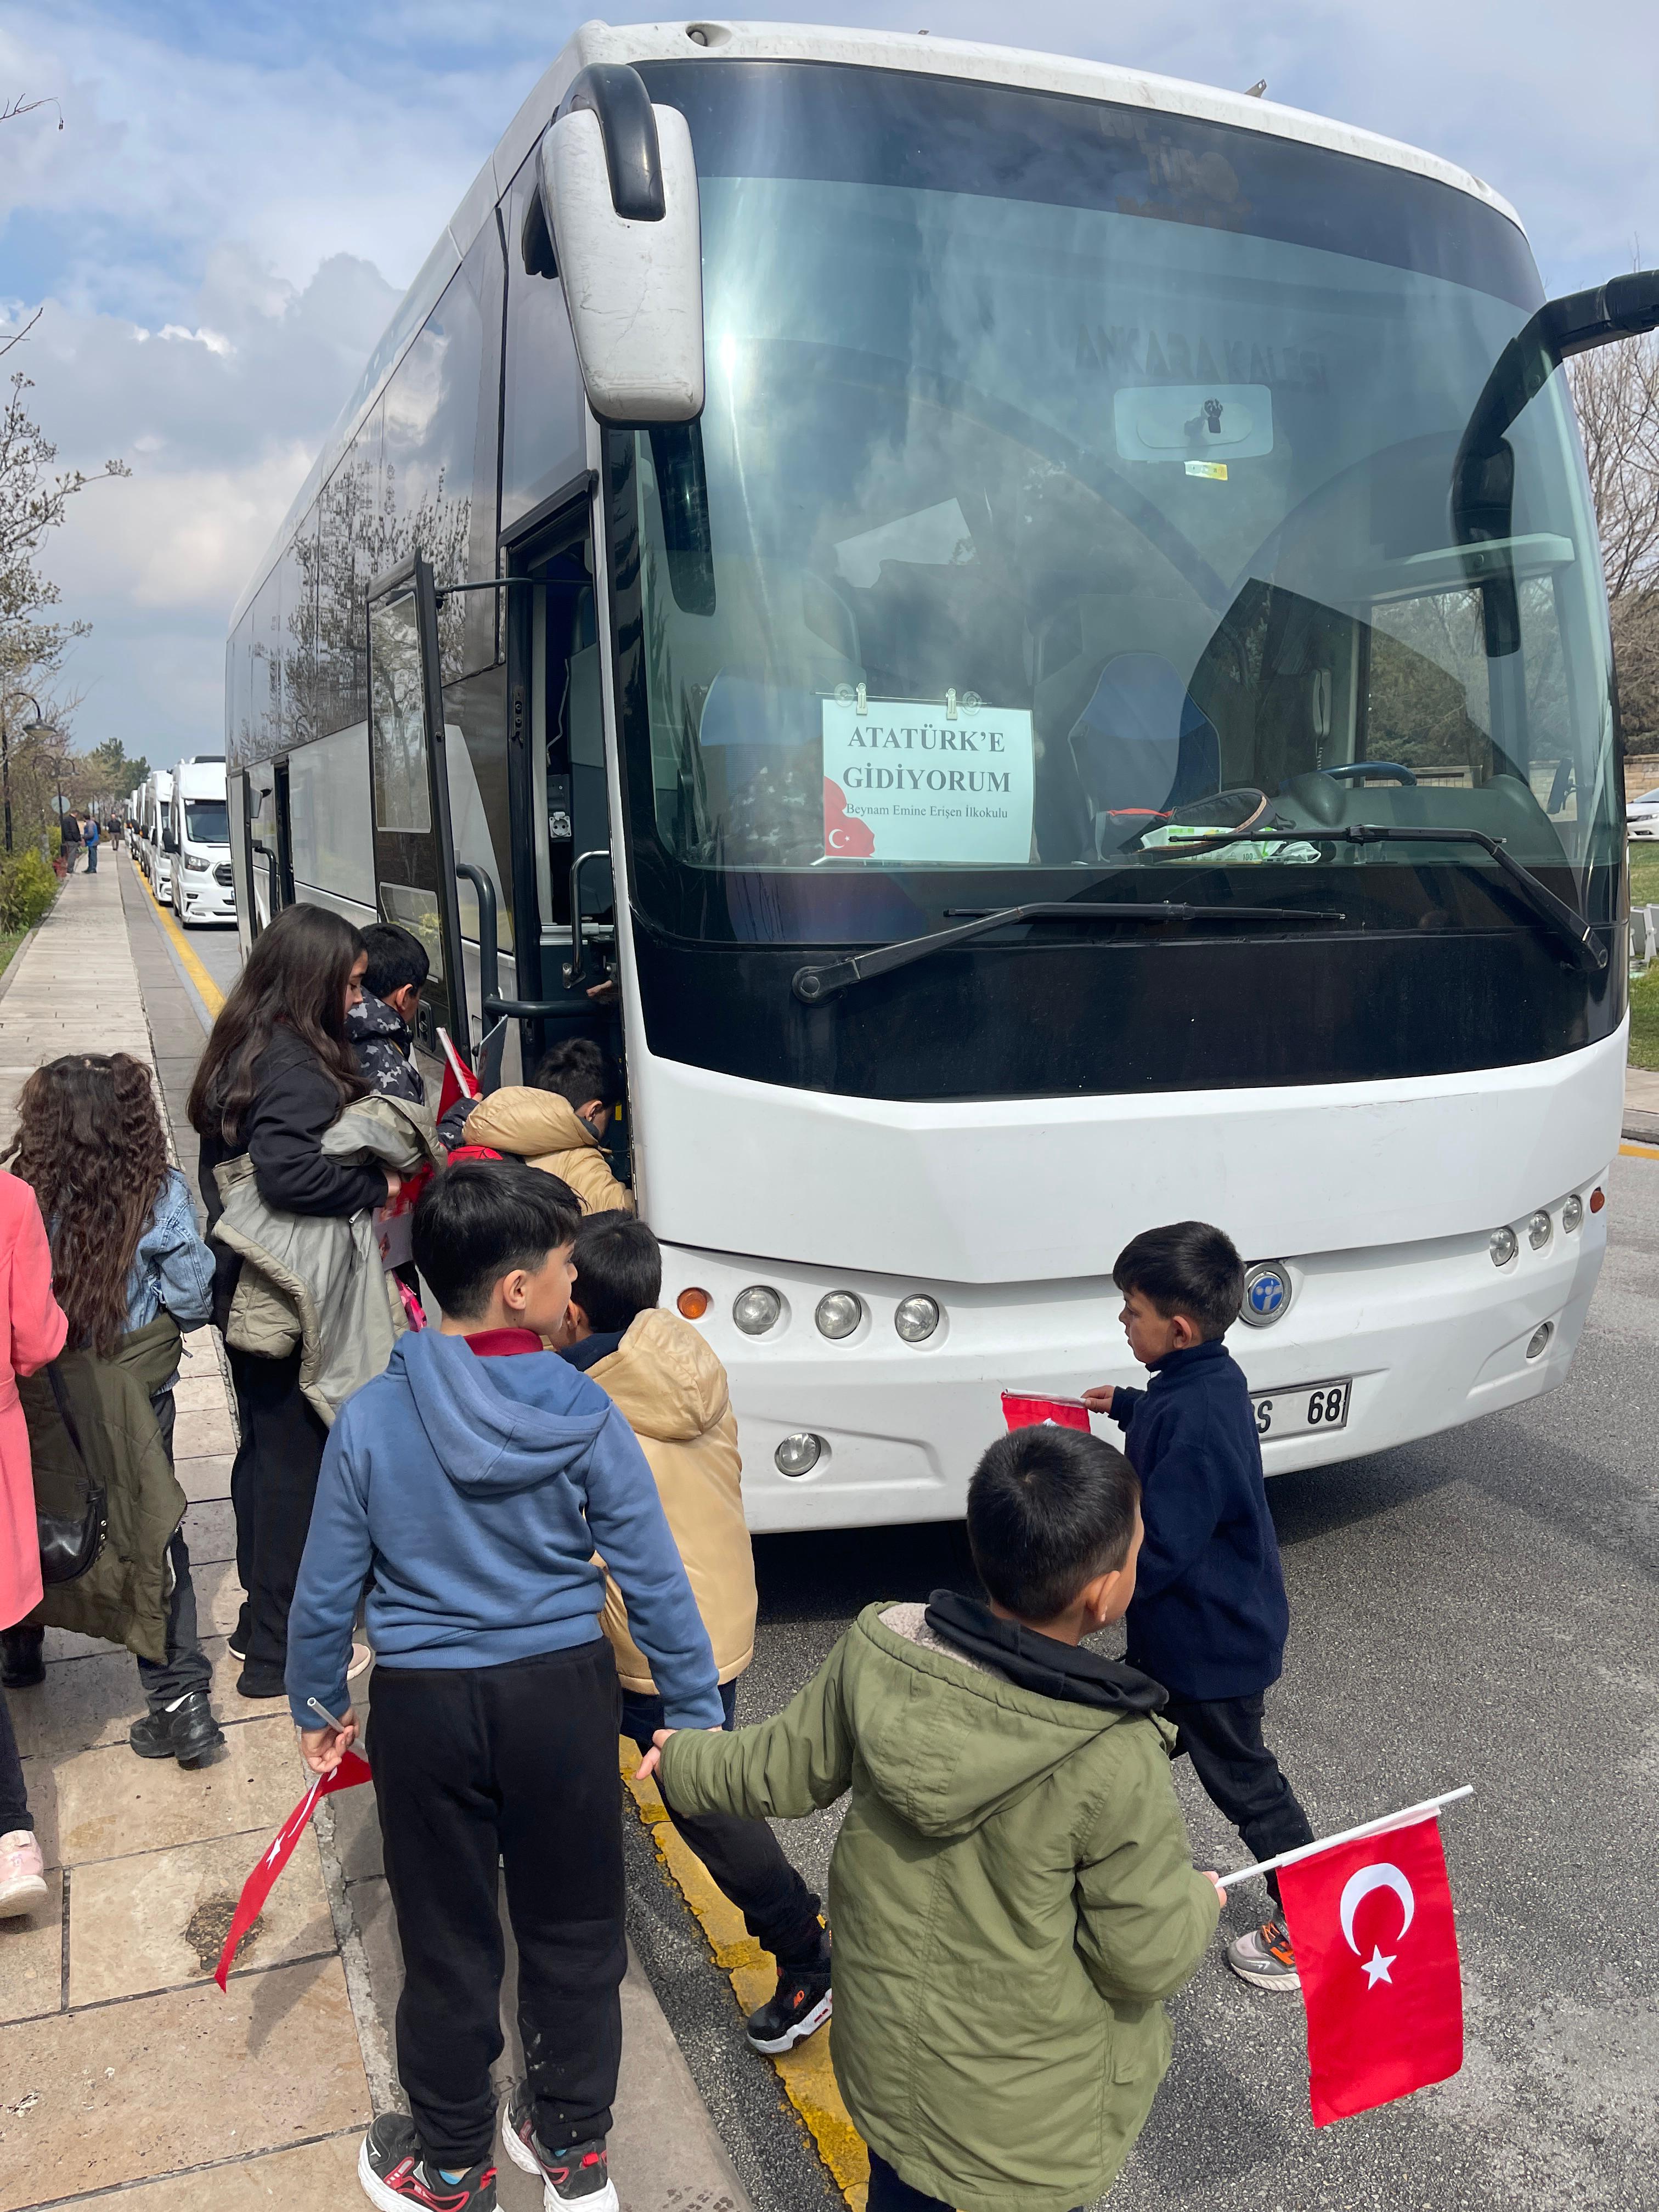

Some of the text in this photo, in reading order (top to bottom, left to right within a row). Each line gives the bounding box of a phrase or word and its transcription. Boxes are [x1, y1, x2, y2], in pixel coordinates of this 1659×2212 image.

[848, 724, 1005, 752] ATATÜRK’E
[843, 763, 1011, 792] GİDİYORUM
[847, 803, 1008, 820] Beynam Emine Erişen İlkokulu
[1253, 1389, 1342, 1433] S 68
